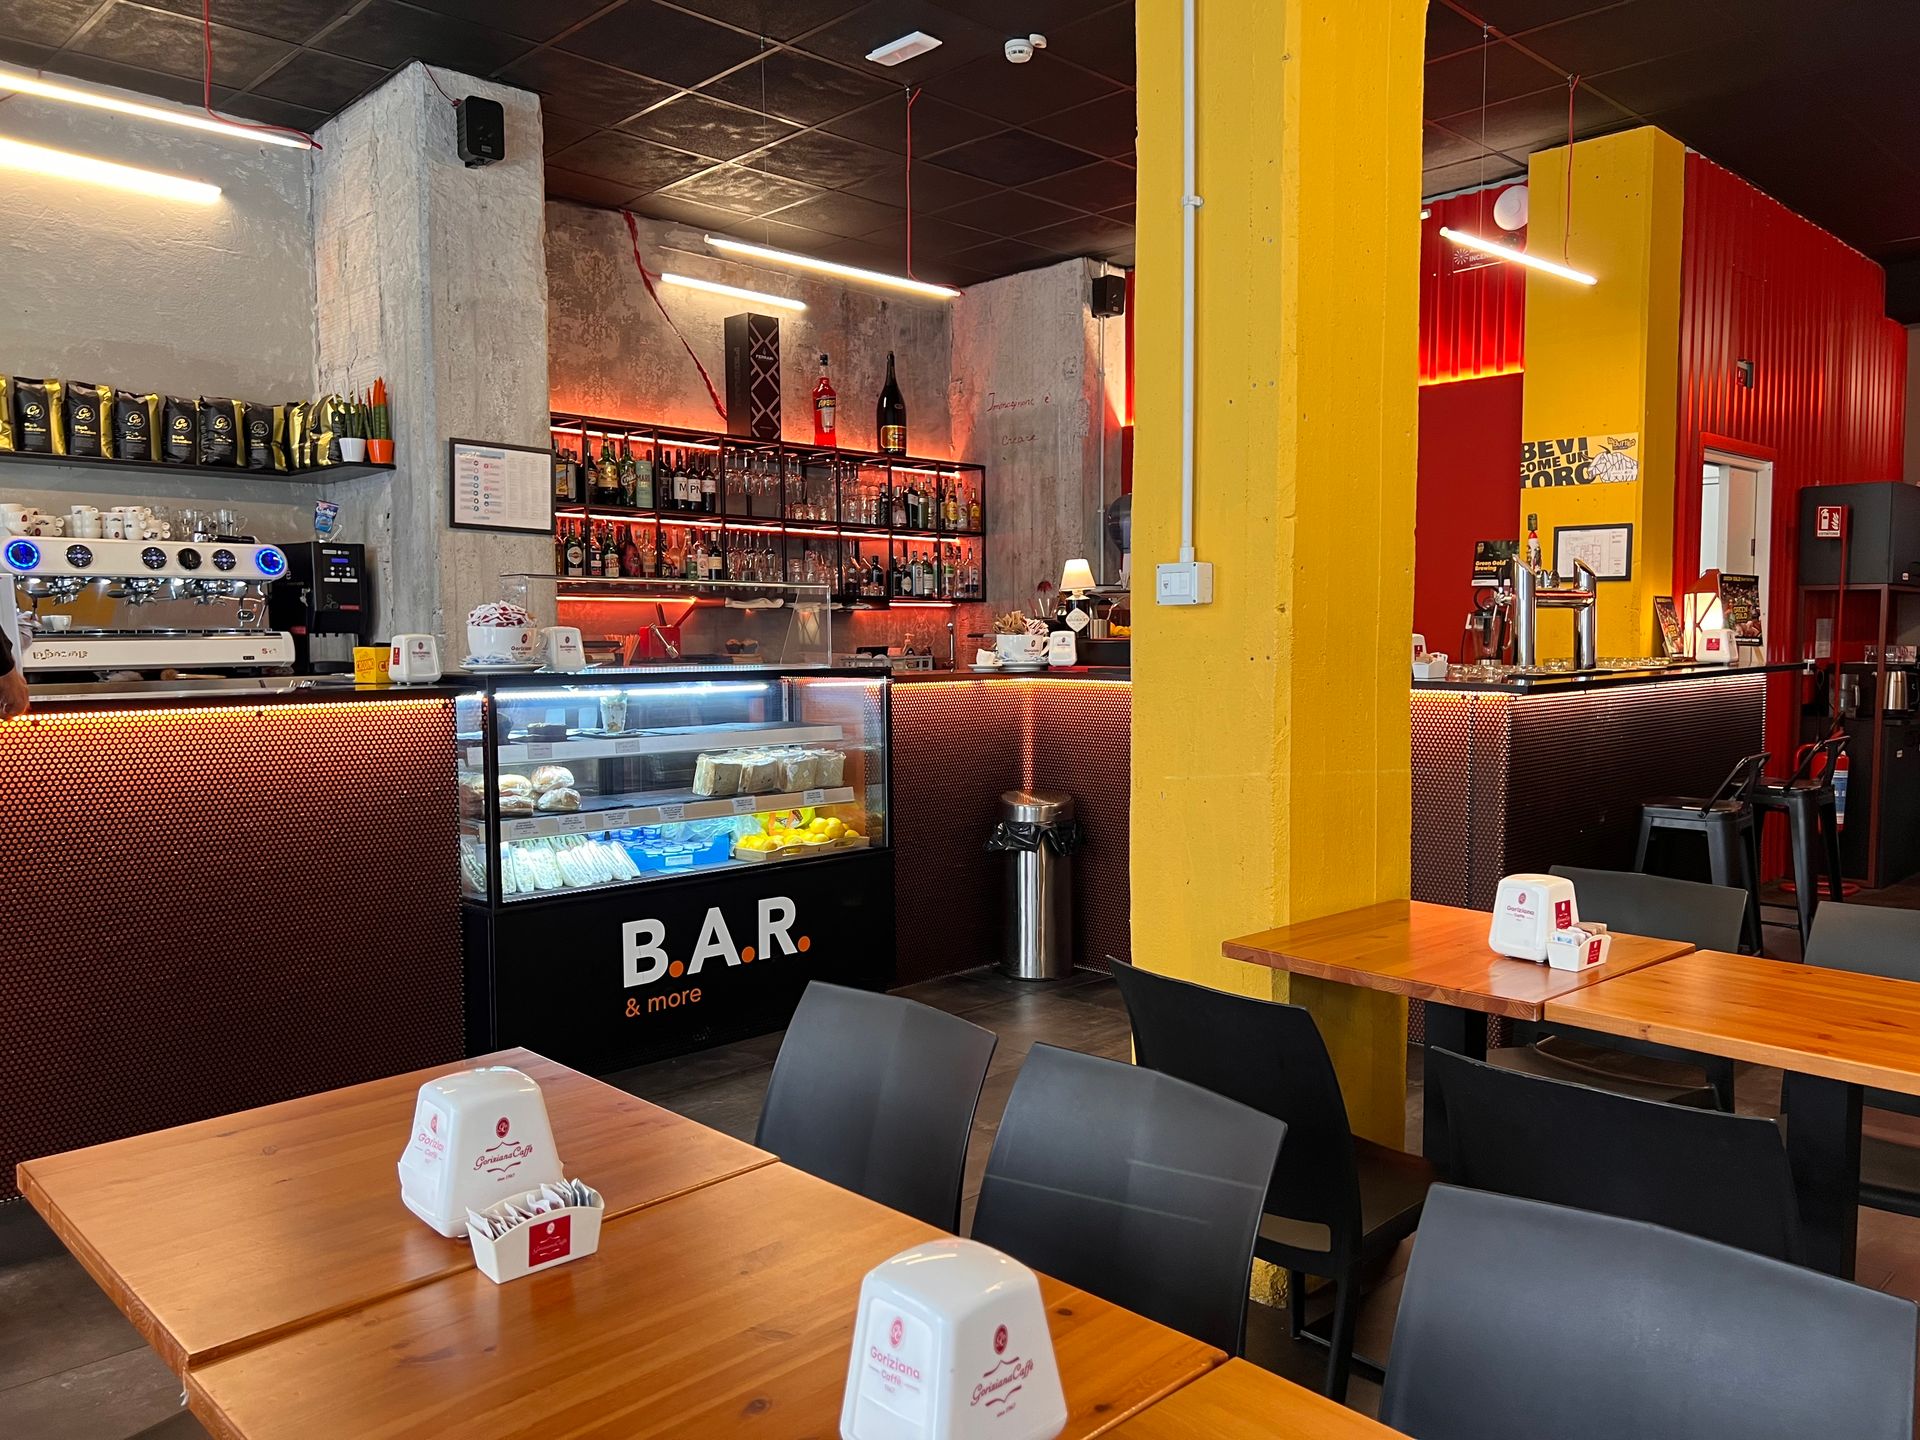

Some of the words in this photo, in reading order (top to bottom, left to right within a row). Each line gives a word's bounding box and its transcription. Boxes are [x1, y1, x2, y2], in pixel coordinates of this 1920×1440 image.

[1521, 437, 1588, 463] BEVI
[625, 998, 641, 1018] &
[648, 988, 702, 1013] more
[870, 1346, 921, 1380] Goriziana
